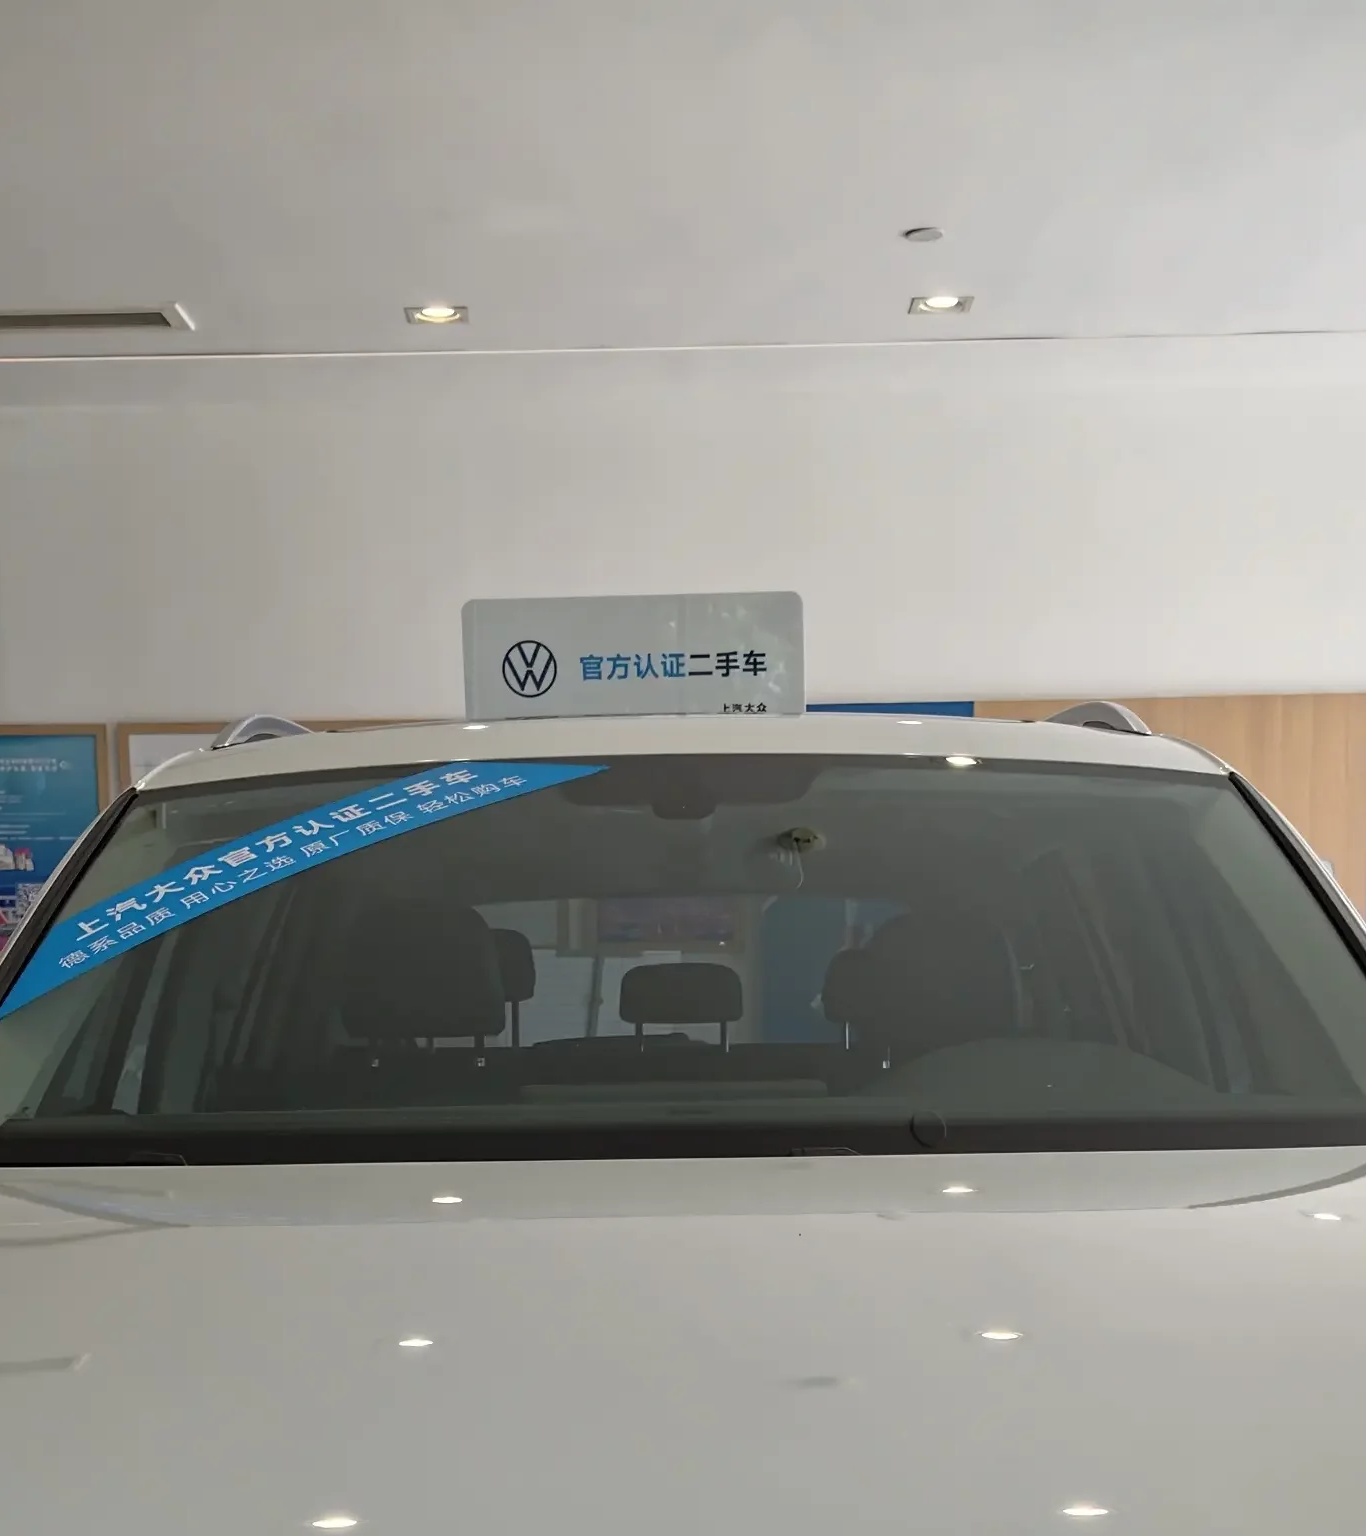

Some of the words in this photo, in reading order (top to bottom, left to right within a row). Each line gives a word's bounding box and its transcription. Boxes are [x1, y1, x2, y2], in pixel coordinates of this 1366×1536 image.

[579, 650, 768, 681] 官方认证二手车
[723, 702, 767, 713] 上汽大众
[58, 906, 173, 970] 德系品质
[180, 854, 296, 910] 用心之选
[299, 810, 414, 858] 原厂质保
[416, 774, 528, 814] 轻松购车
[76, 769, 479, 941] 上汽大众官方认证二手车
